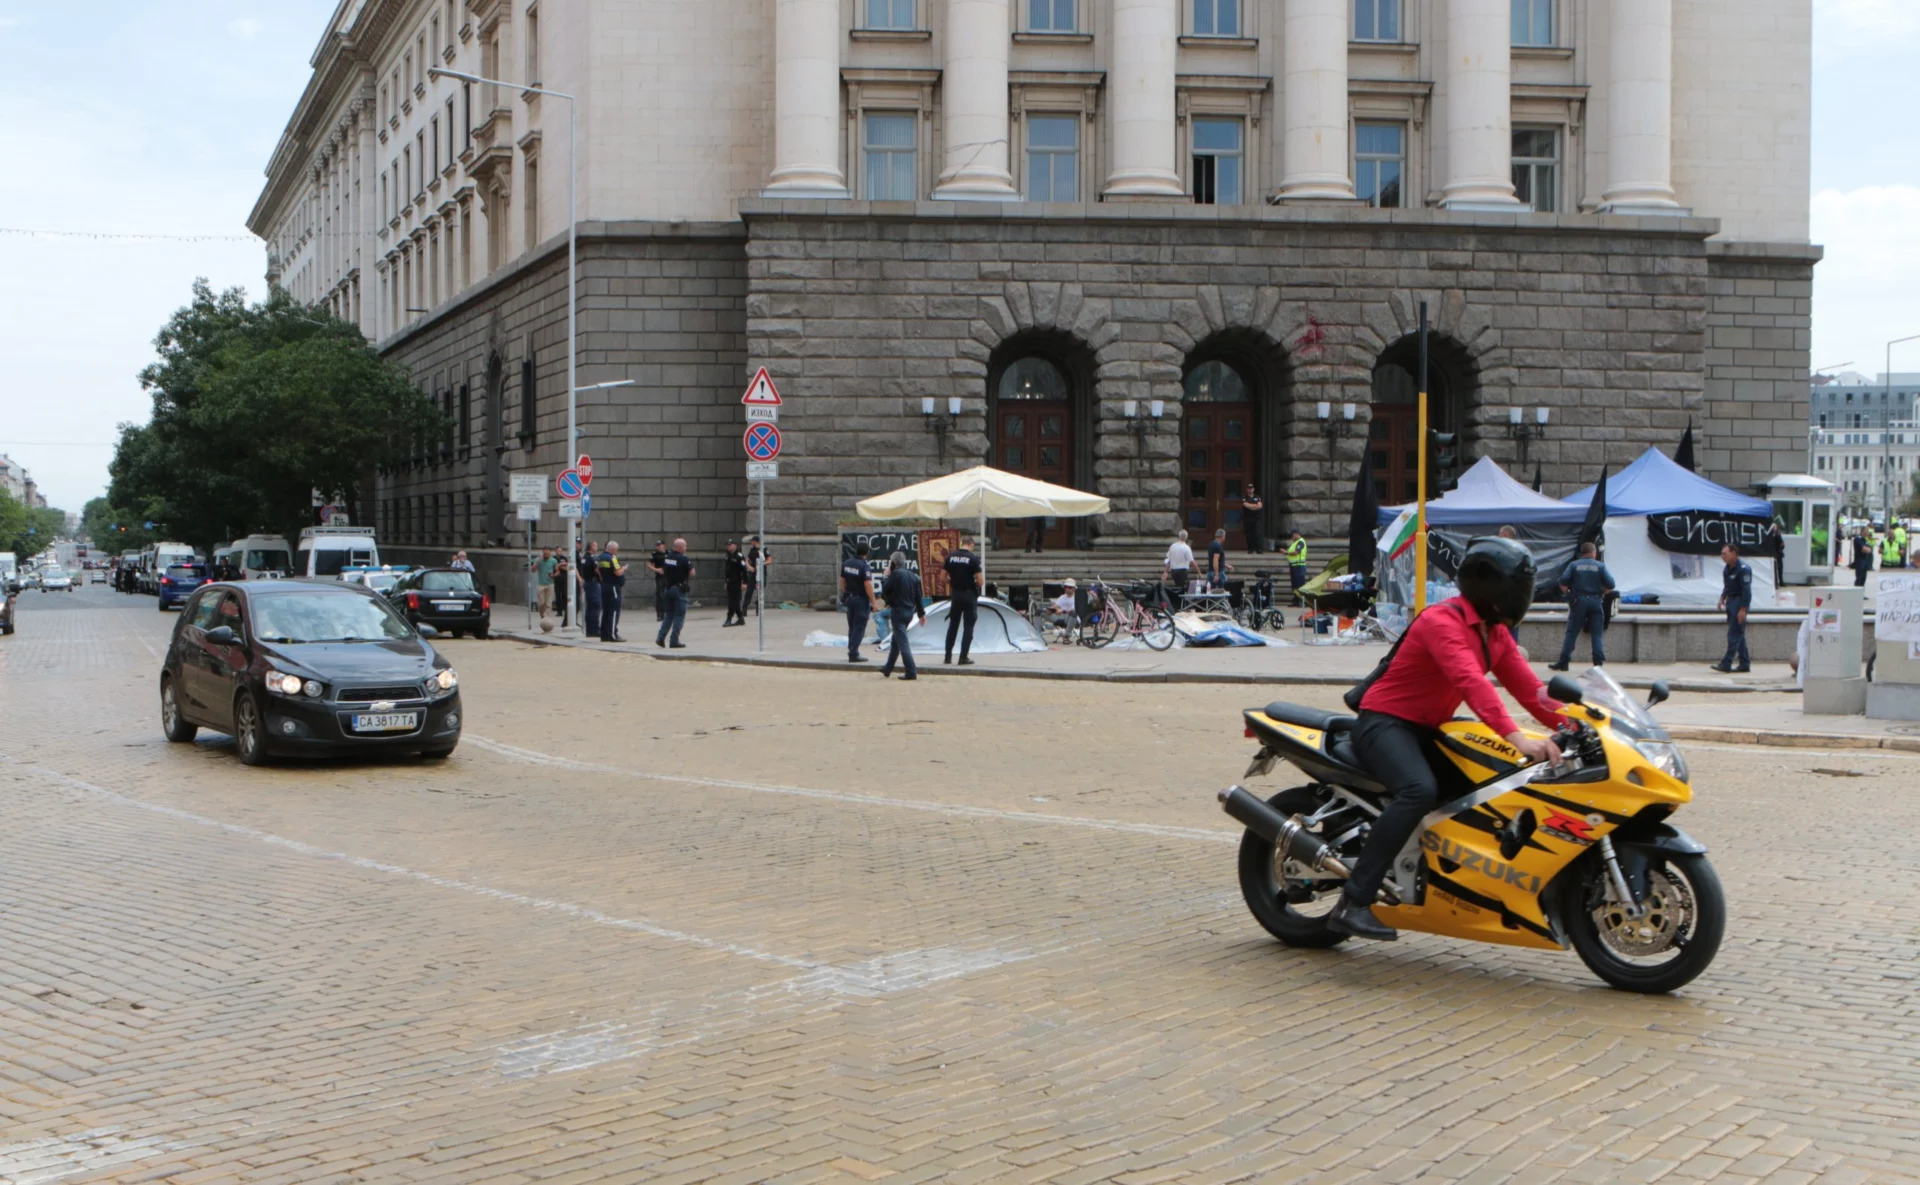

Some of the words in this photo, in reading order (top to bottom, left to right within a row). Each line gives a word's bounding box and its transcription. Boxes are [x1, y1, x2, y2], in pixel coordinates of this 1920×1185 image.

[751, 409, 773, 418] ИЗХОД
[578, 465, 592, 476] STOP
[949, 556, 970, 565] POLICE
[360, 716, 373, 727] CA
[375, 715, 399, 727] 3817
[401, 714, 415, 725] TA
[1464, 732, 1517, 757] SUZUKI
[1423, 829, 1541, 895] SUZUKI
